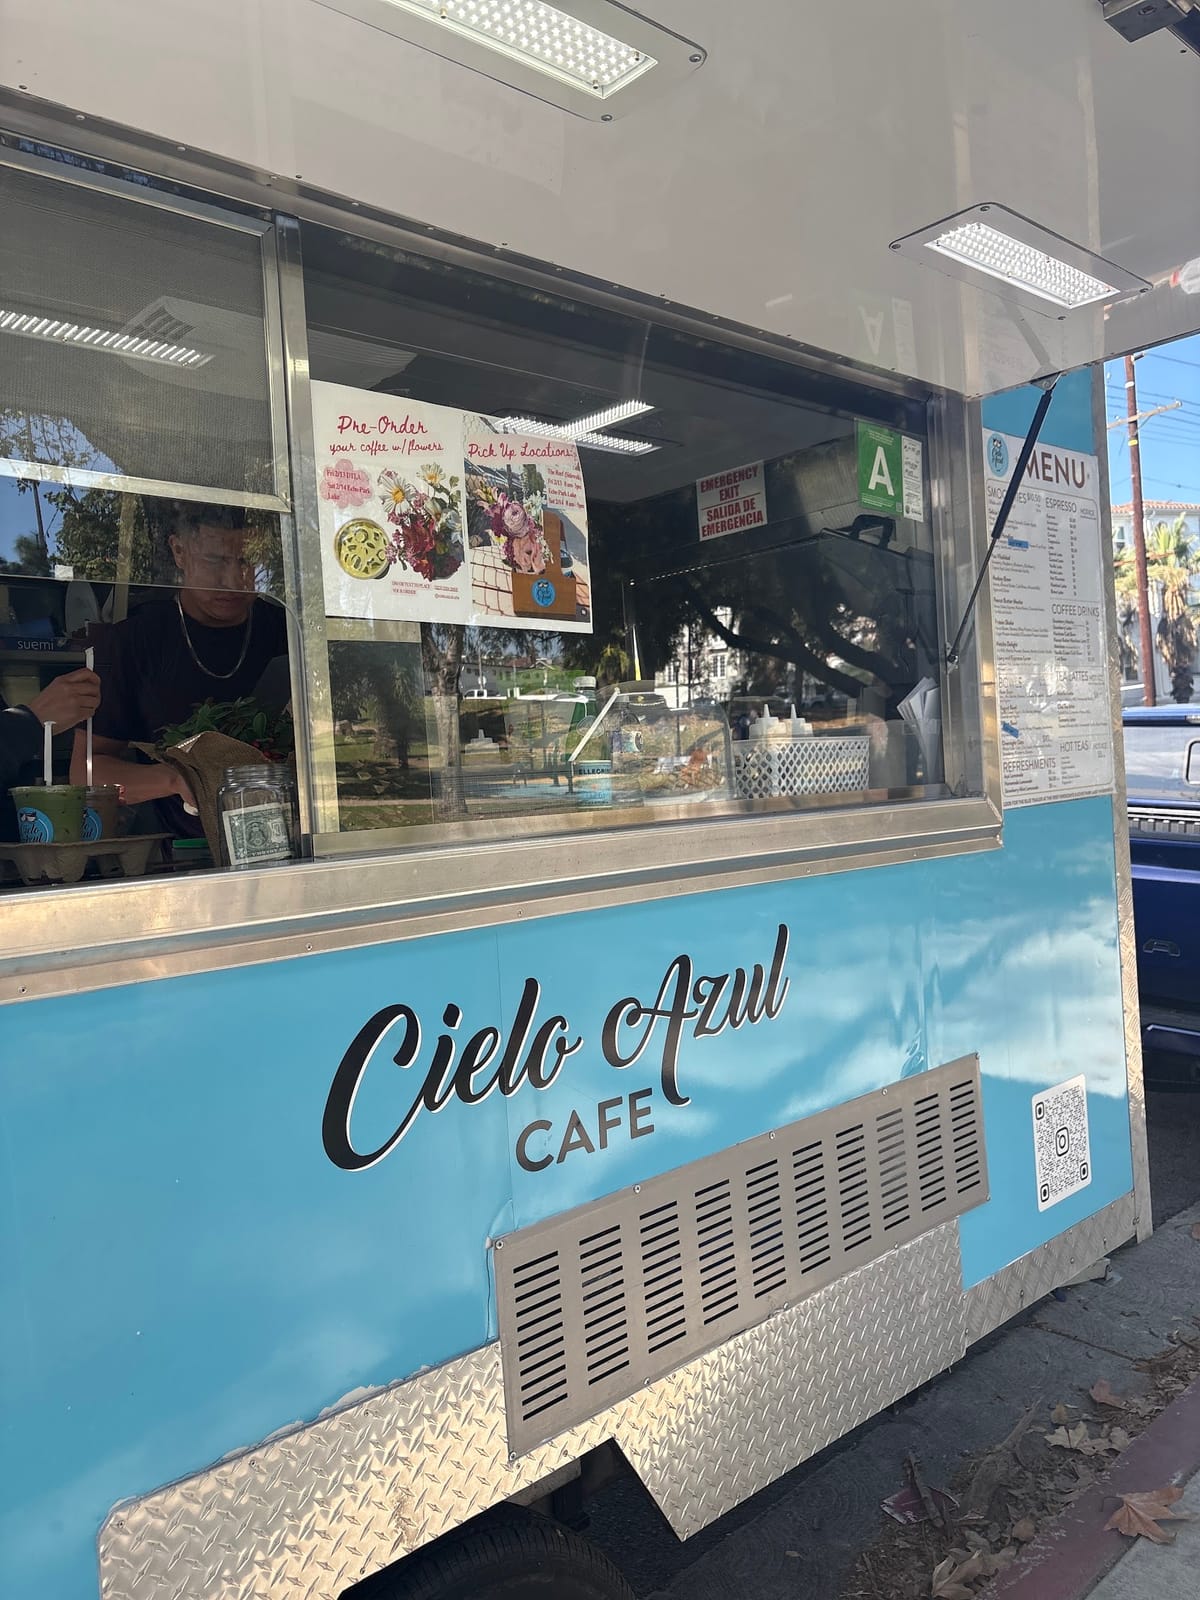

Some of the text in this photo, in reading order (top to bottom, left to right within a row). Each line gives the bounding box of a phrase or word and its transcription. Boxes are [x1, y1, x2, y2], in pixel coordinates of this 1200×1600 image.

[337, 415, 428, 435] Pre-Order
[329, 443, 357, 456] your
[360, 441, 389, 456] coffee
[468, 443, 497, 458] Pick
[500, 443, 516, 461] Up
[700, 465, 759, 493] EMERGENCY
[868, 446, 894, 496] A
[1026, 450, 1086, 489] MENU
[719, 484, 741, 502] EXIT
[706, 497, 757, 522] SALIDA DE
[1045, 496, 1078, 513] ESPRESSO
[701, 510, 764, 538] EMERGENCIA
[1052, 603, 1077, 616] COFFEE
[1078, 606, 1100, 618] DRINKS
[1060, 741, 1073, 753] HOT
[1074, 740, 1089, 752] TEAS
[1003, 757, 1056, 774] REFRESHMENTS
[321, 923, 791, 1173] Cielo Azul
[515, 1087, 656, 1173] CAFE
